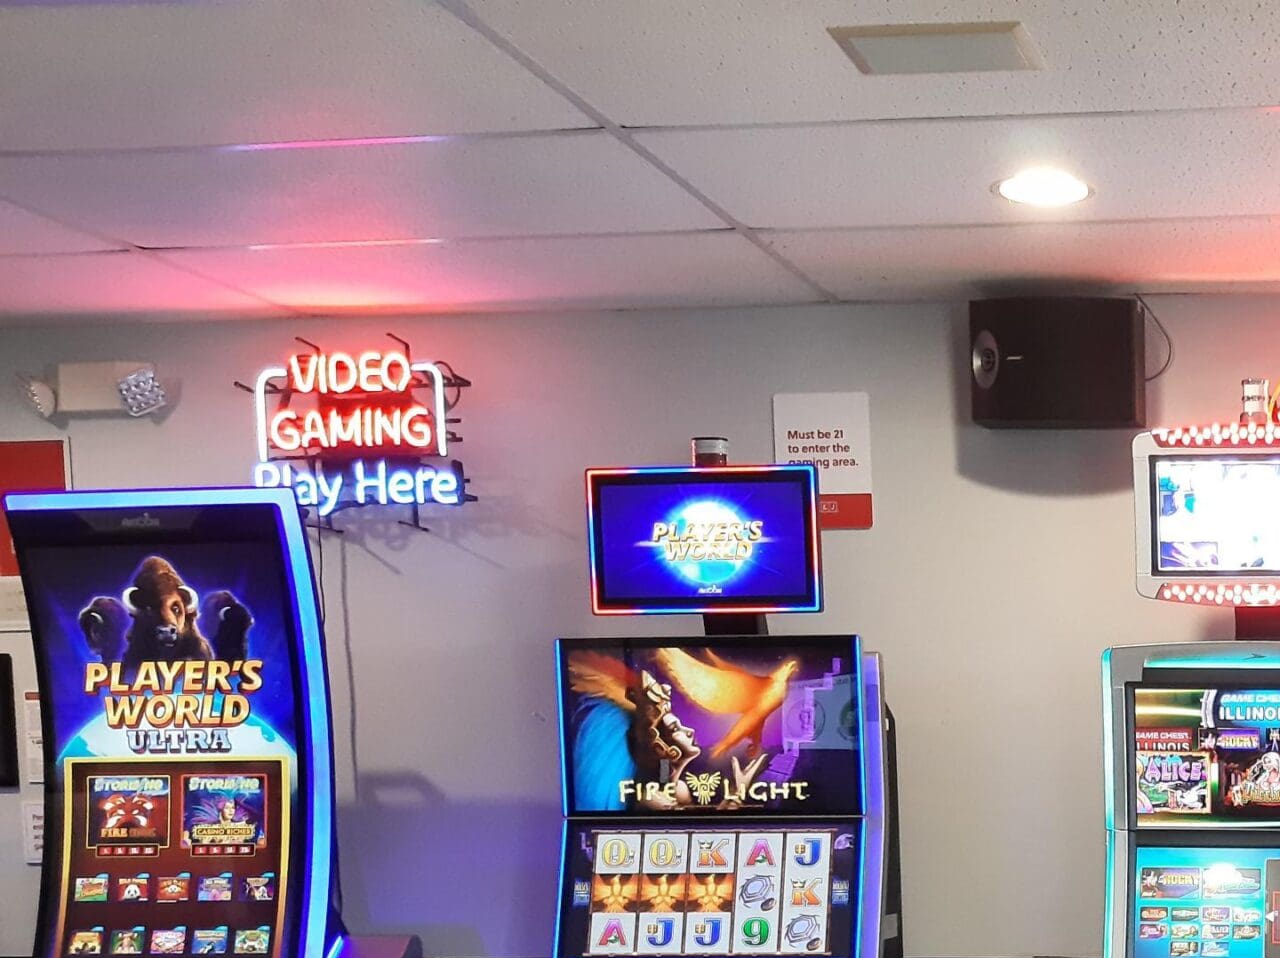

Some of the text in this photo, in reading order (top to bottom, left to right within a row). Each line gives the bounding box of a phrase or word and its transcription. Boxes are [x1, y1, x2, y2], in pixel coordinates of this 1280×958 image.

[290, 353, 411, 394] VIDEO
[270, 406, 432, 450] GAMING
[787, 429, 844, 440] Must be 21
[788, 443, 851, 454] to enter the
[832, 458, 859, 467] area.
[254, 460, 459, 515] Play Here
[652, 521, 764, 543] PLAYER'S
[664, 541, 753, 562] WORLD
[84, 659, 264, 695] PLAYER'S
[104, 694, 251, 728] WORLD
[126, 729, 233, 753] ULTRA
[1145, 757, 1201, 782] ALICE
[618, 779, 810, 802] FIRE LIGHT
[747, 838, 776, 867] A
[598, 918, 626, 947] A
[743, 916, 770, 947] 9
